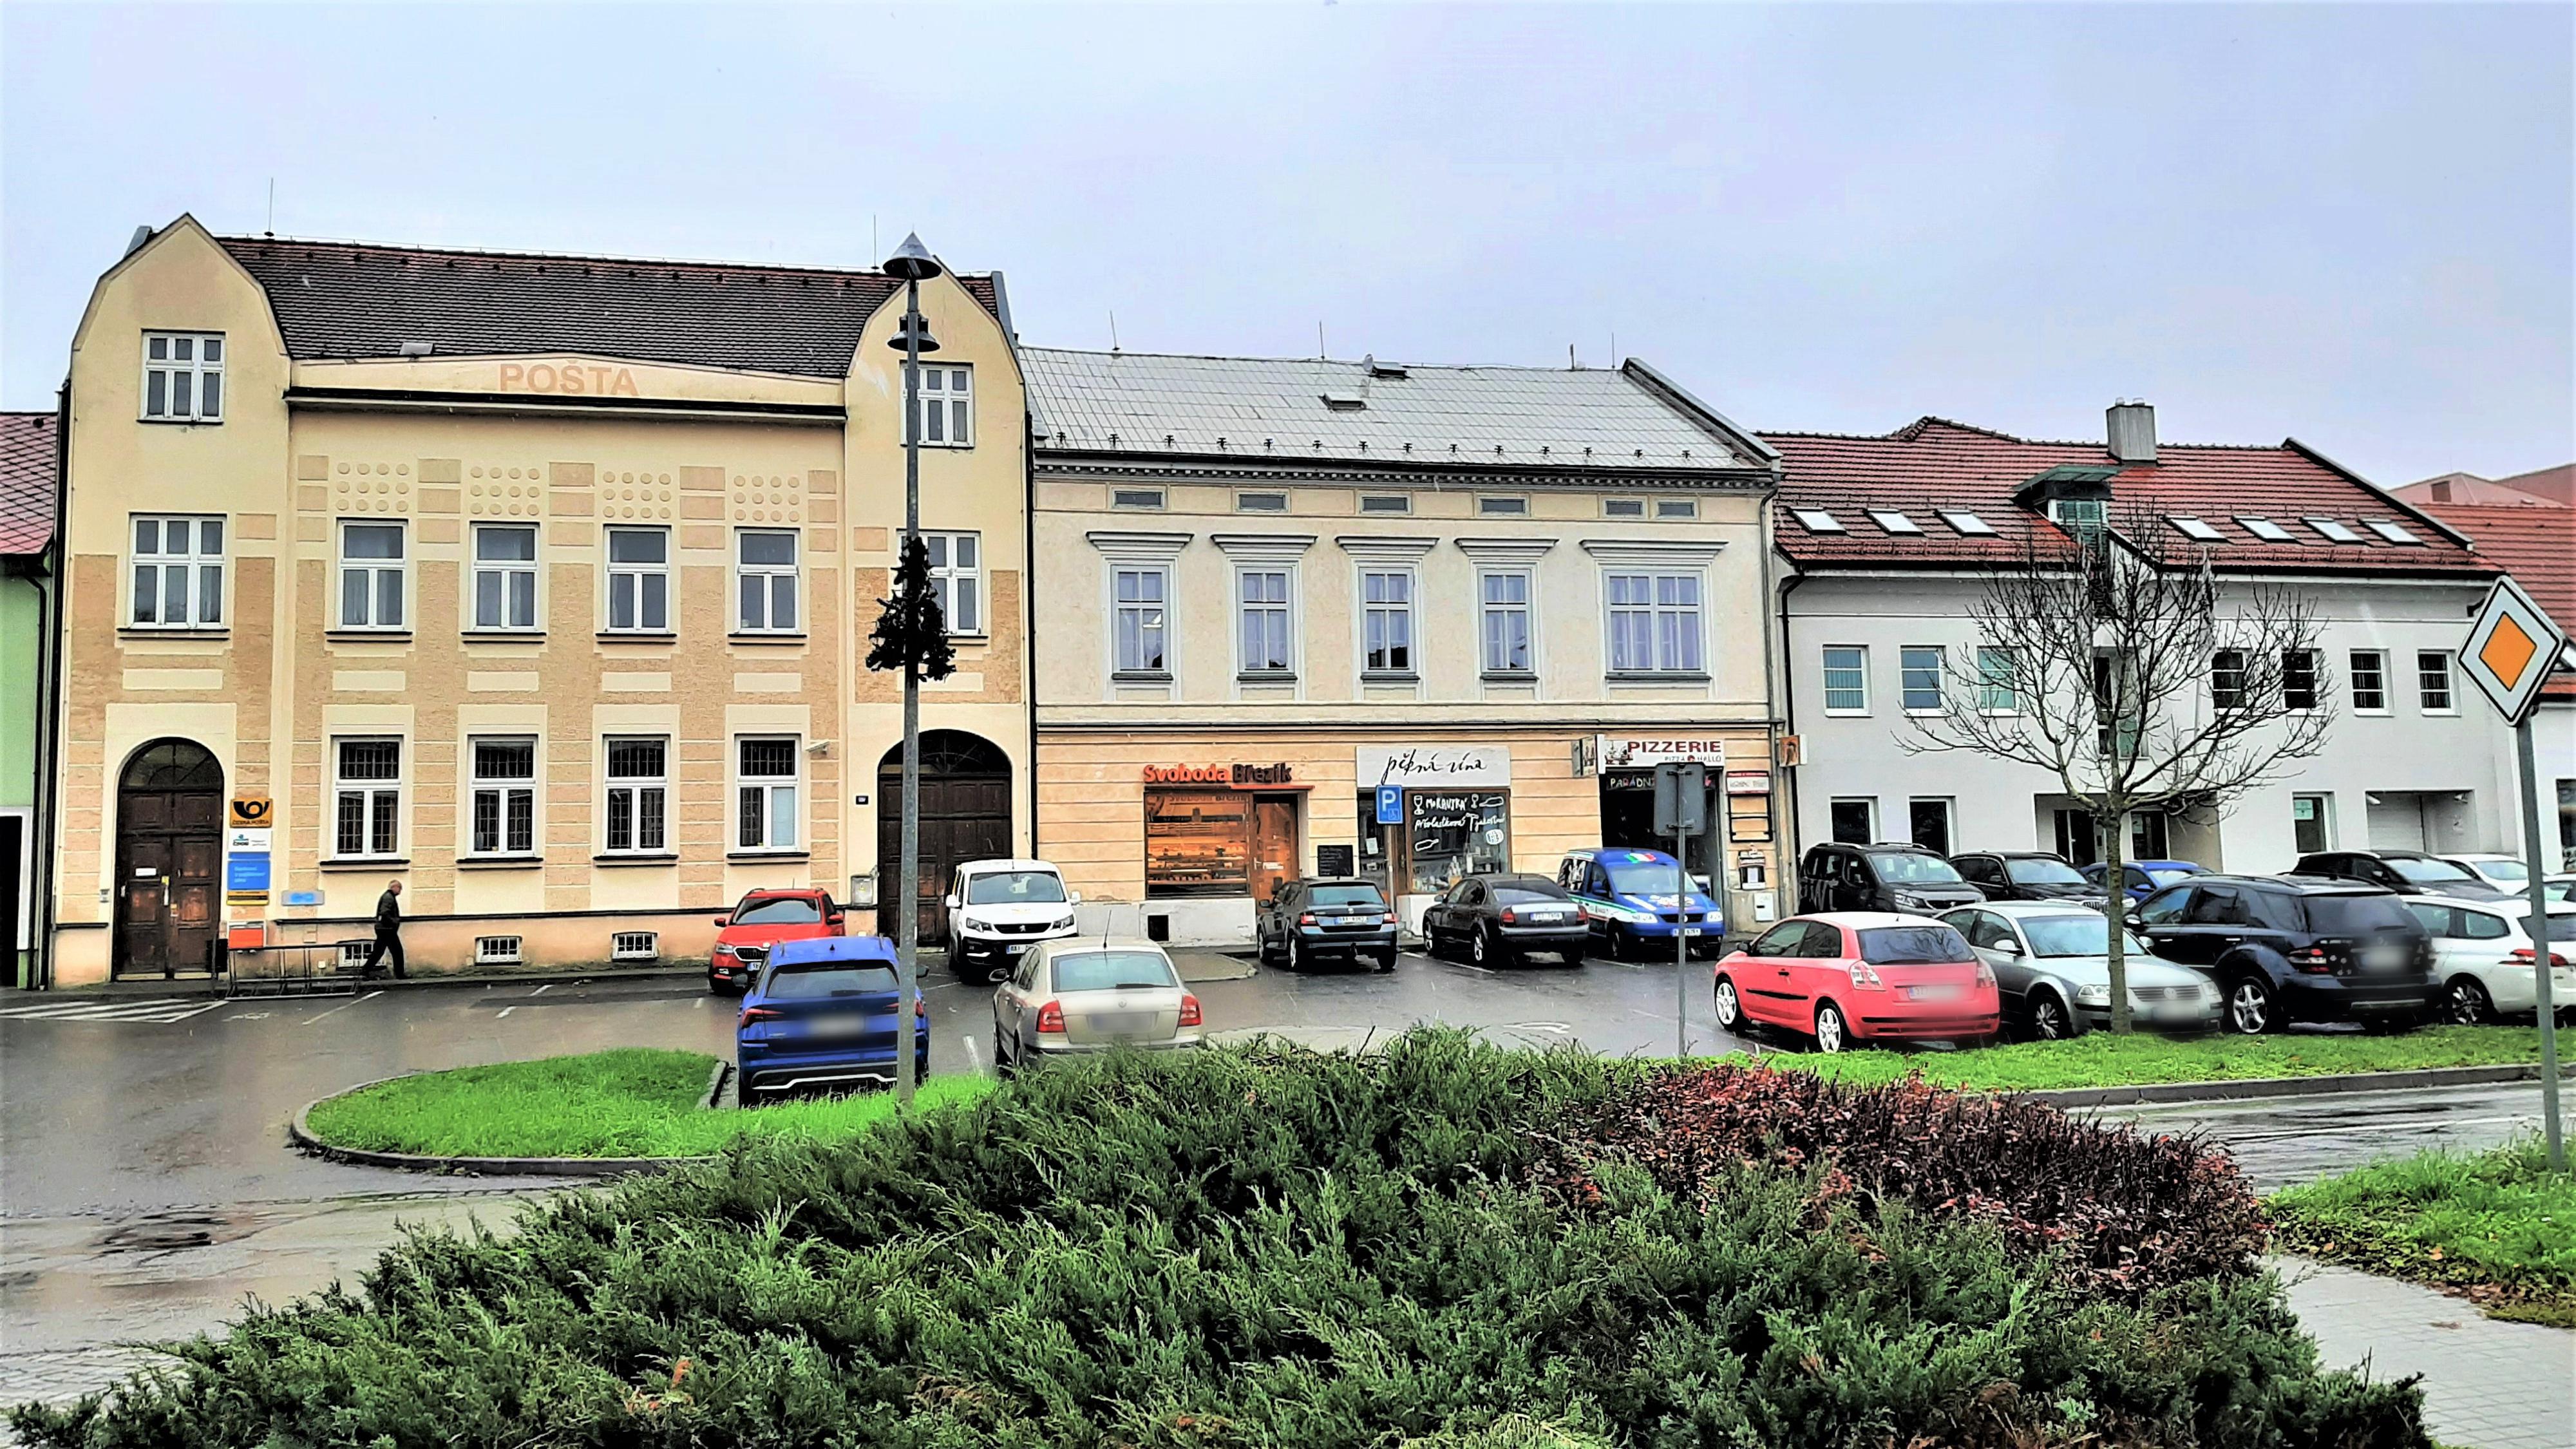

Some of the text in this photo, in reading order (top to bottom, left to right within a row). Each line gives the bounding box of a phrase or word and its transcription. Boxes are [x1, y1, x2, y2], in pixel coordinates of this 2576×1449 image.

[500, 359, 639, 396] POŠTA
[1627, 741, 1721, 753] PIZZERIE
[1143, 763, 1231, 783] Svoboda
[1447, 752, 1487, 773] vína
[1382, 790, 1396, 811] P
